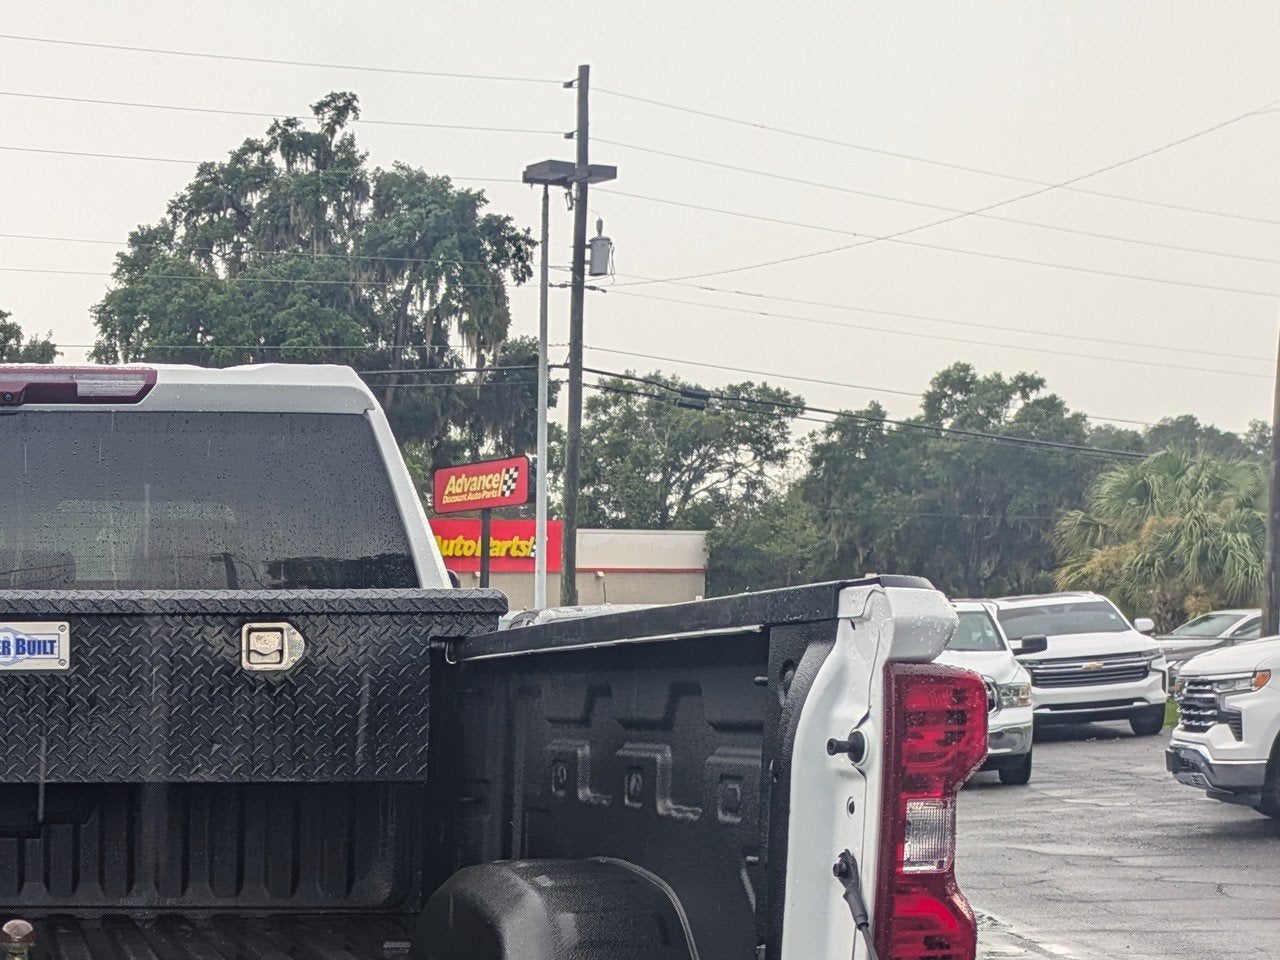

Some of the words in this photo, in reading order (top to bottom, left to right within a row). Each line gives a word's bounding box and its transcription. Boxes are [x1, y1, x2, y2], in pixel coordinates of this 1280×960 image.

[444, 472, 500, 495] Advance
[467, 491, 482, 501] Auto
[482, 489, 498, 499] Parts
[15, 637, 57, 656] BUILT
